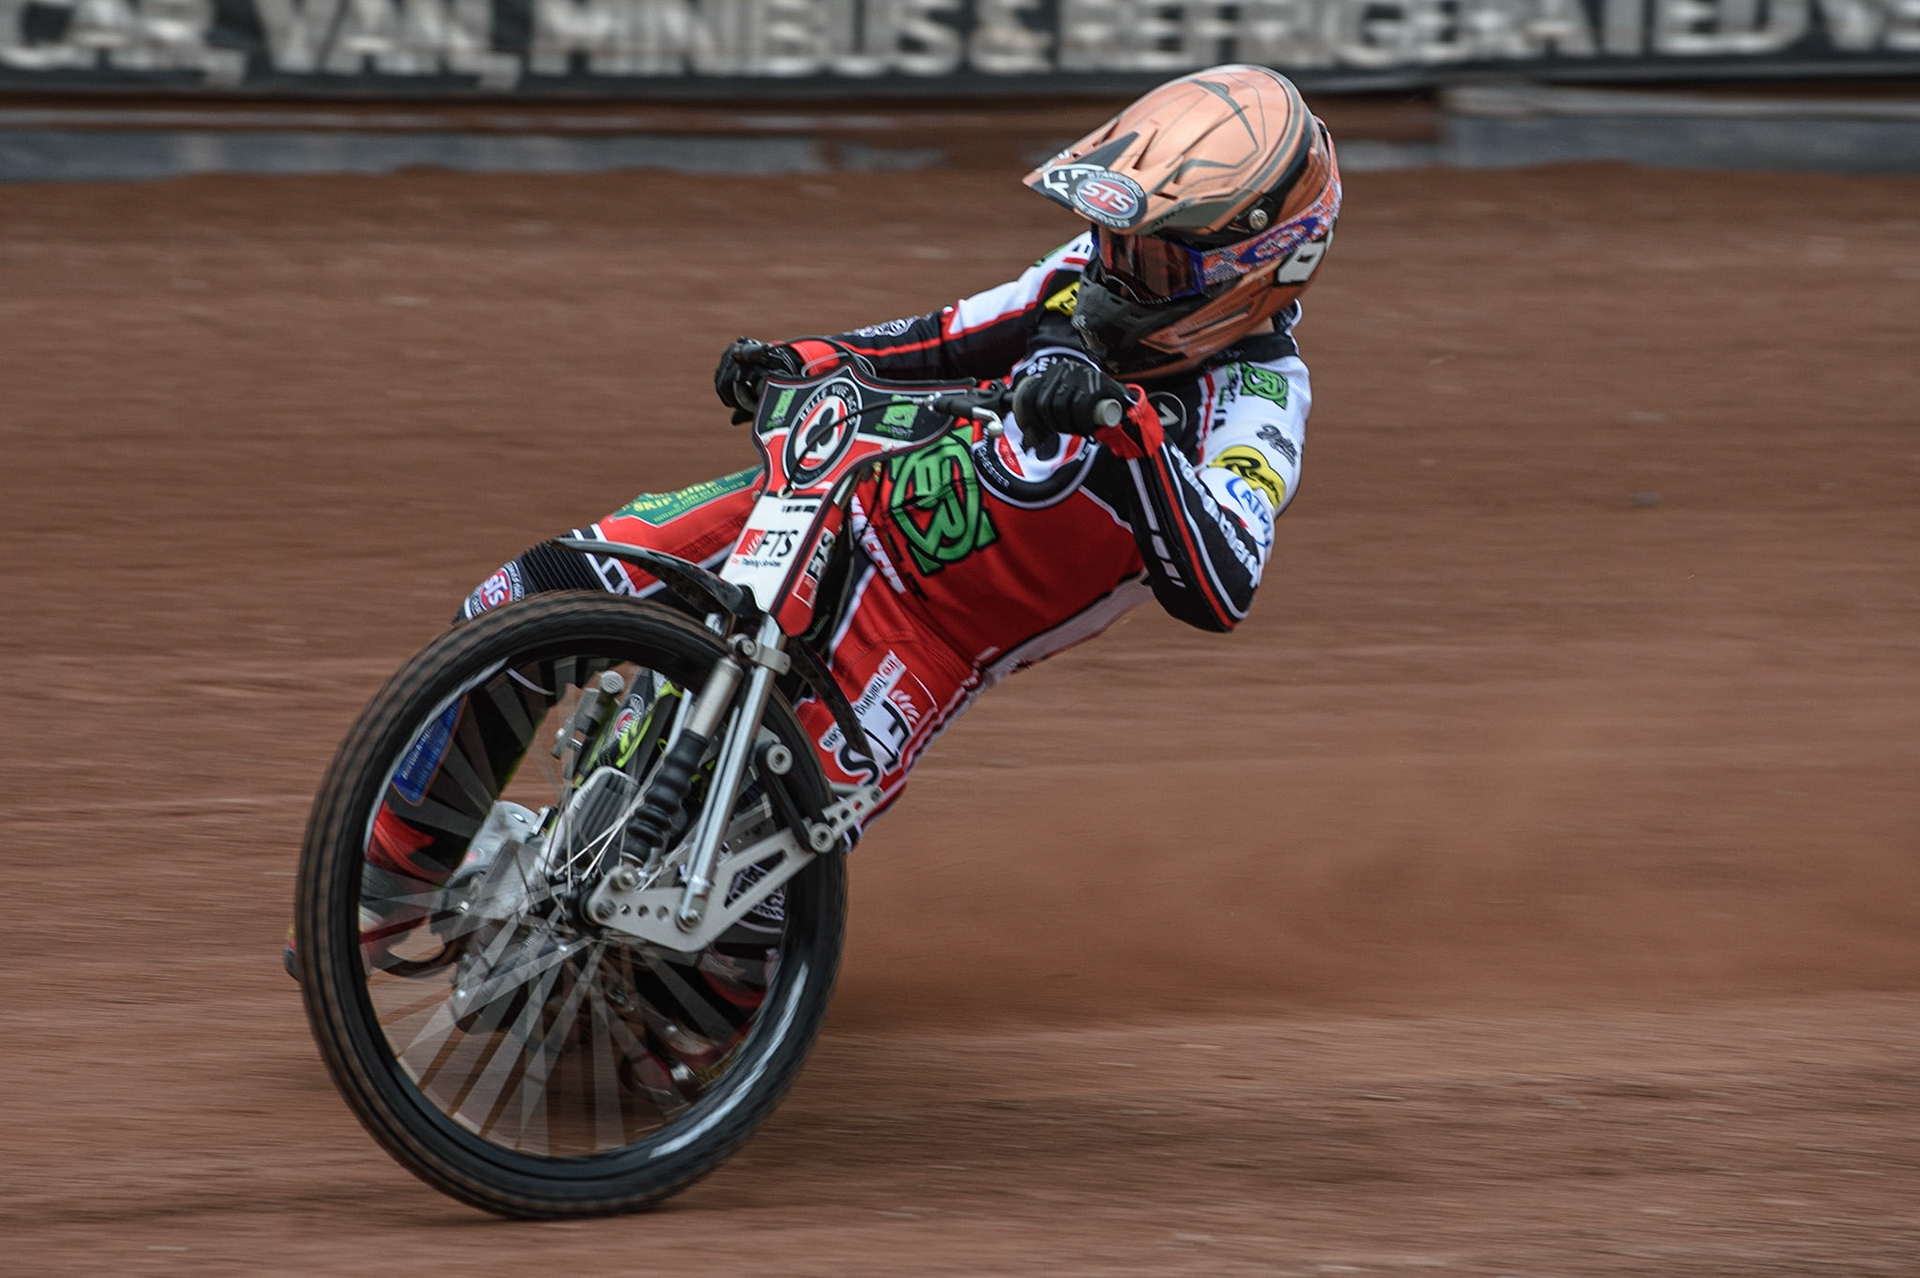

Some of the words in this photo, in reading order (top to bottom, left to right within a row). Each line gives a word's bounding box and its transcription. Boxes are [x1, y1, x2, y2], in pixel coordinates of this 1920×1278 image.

[256, 0, 521, 90] VAN,
[529, 0, 963, 76] MINIBUS
[968, 0, 1056, 74] &
[1080, 181, 1136, 213] STS
[754, 529, 799, 557] FTS
[840, 699, 910, 787] FTS
